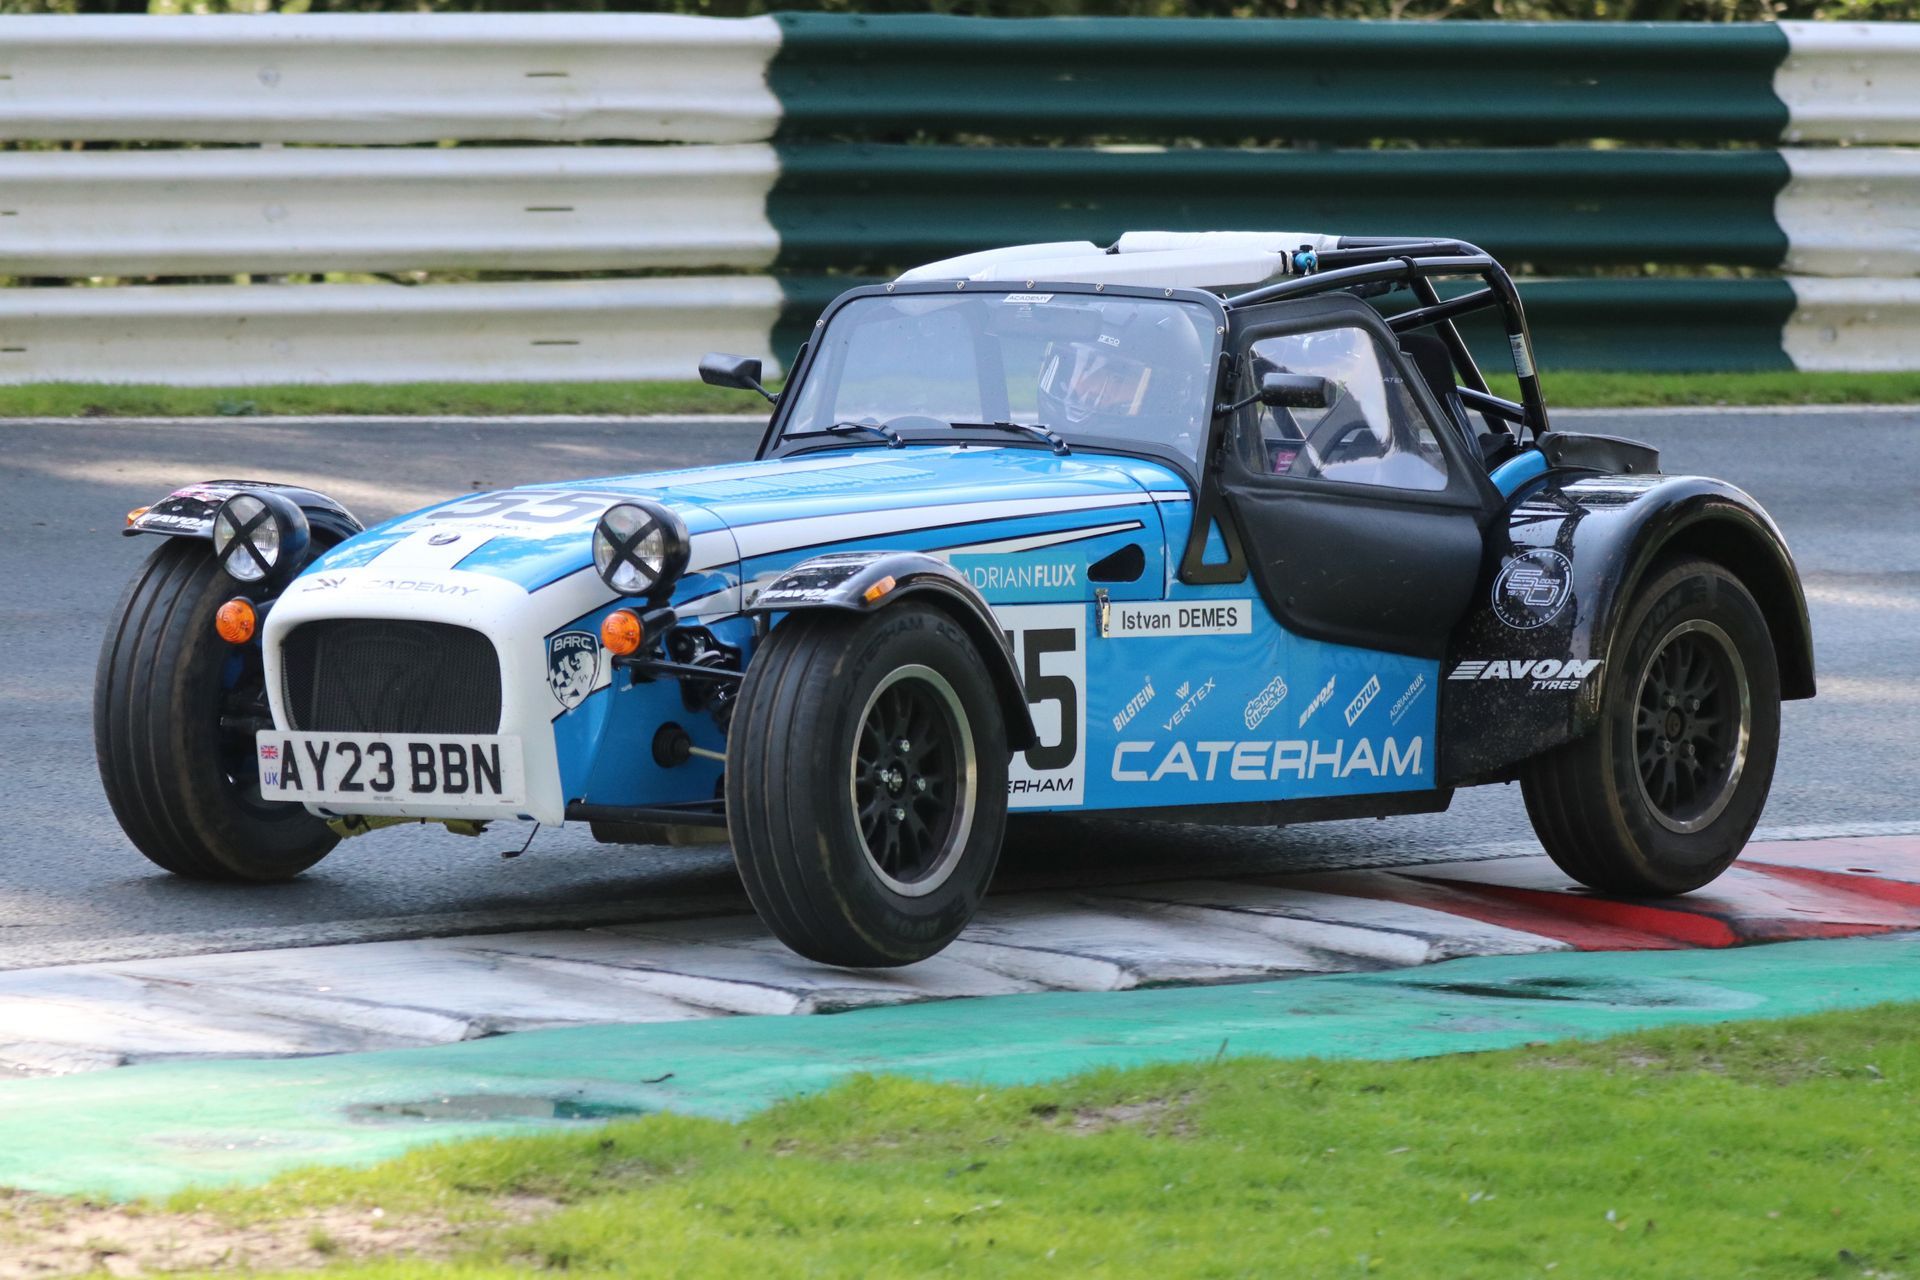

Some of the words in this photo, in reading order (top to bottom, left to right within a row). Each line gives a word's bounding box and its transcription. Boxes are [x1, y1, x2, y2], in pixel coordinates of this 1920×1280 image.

[1008, 294, 1051, 302] ACADEMY
[426, 491, 634, 523] 55
[1509, 552, 1570, 572] CELEBRATING
[362, 579, 480, 597] CADEMY
[1121, 610, 1171, 630] Istvan
[1178, 606, 1238, 628] DEMES
[553, 636, 592, 652] BARC
[1480, 658, 1601, 680] AVON
[1530, 680, 1581, 690] TYRES
[1112, 683, 1156, 733] BILSTEIN
[1163, 676, 1216, 731] VERTEX
[1245, 677, 1284, 718] demon
[1348, 680, 1378, 723] MOTUL
[279, 740, 396, 793] AY23
[407, 742, 503, 795] BBN
[1111, 735, 1423, 782] CATERHAM
[264, 771, 279, 786] UK
